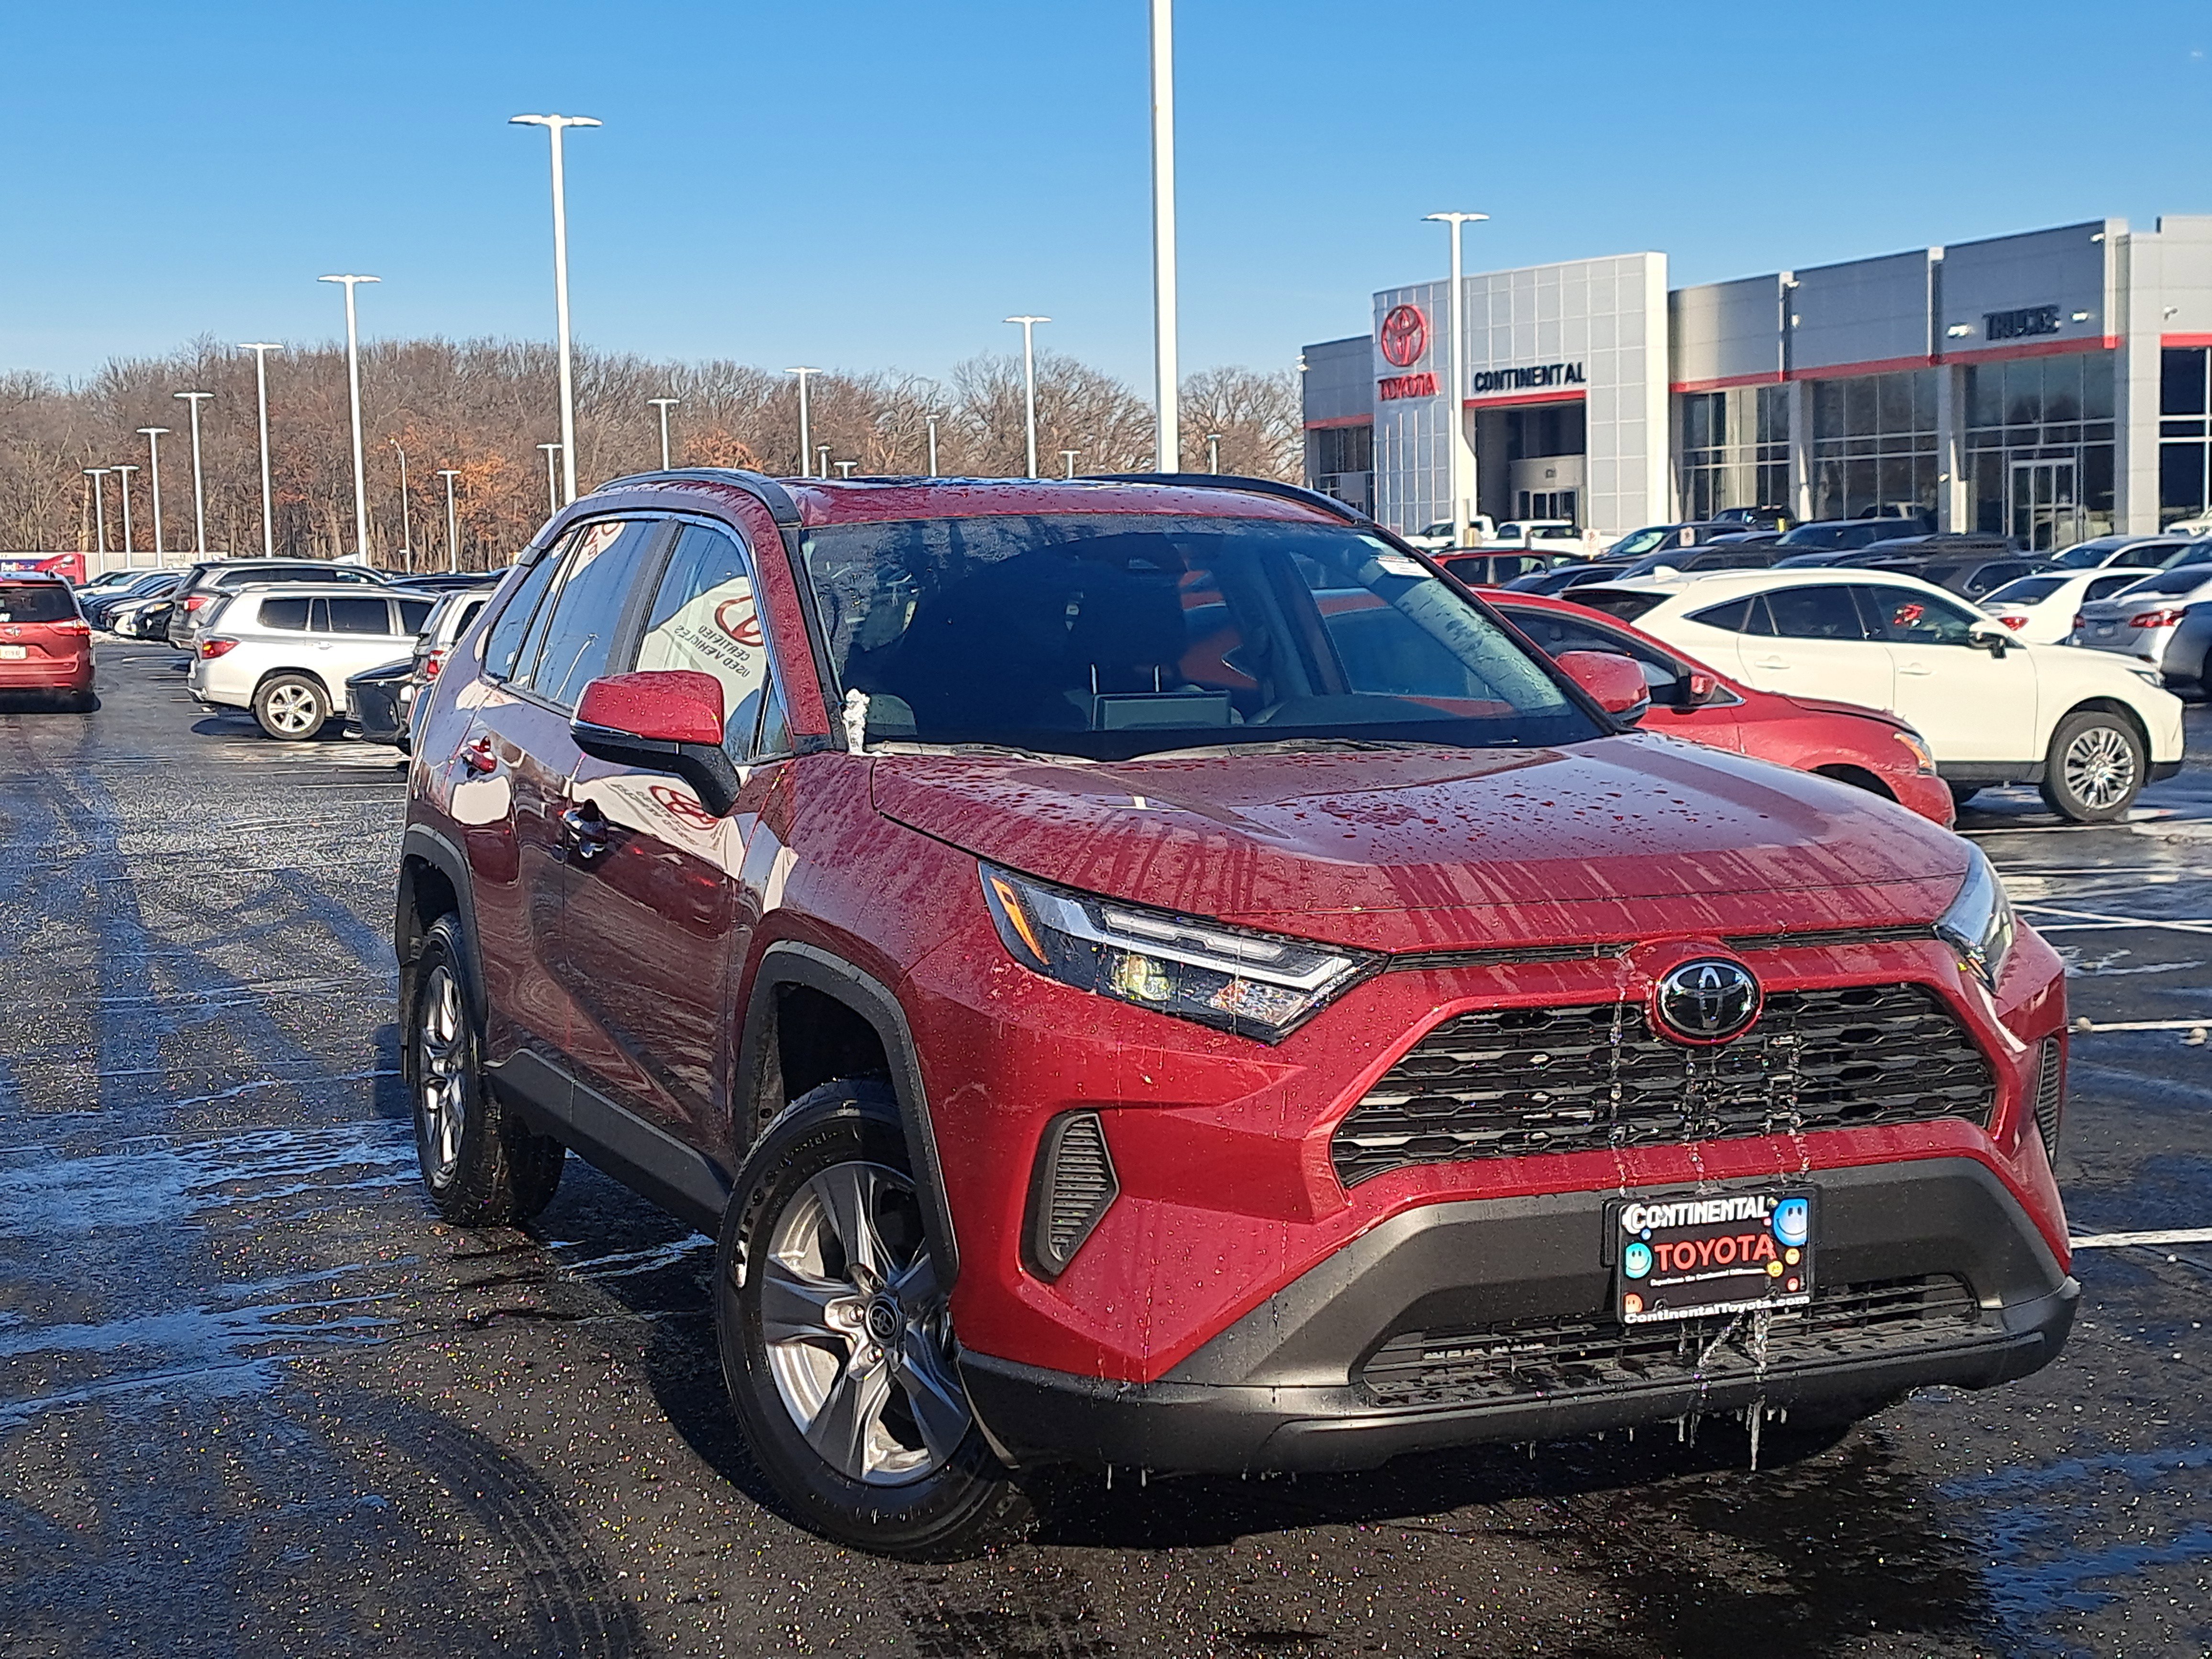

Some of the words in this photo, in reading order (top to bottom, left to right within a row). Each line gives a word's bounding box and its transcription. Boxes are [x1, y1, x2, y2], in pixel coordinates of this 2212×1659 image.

[1981, 304, 2060, 341] TRUCKS
[1378, 372, 1440, 401] TOYOTA
[1475, 362, 1586, 392] CONTINENTAL
[1622, 1196, 1770, 1234] CONTINENTAL
[1655, 1233, 1778, 1272] TOYOTA
[1625, 1296, 1810, 1323] ContinentalToyota.com
